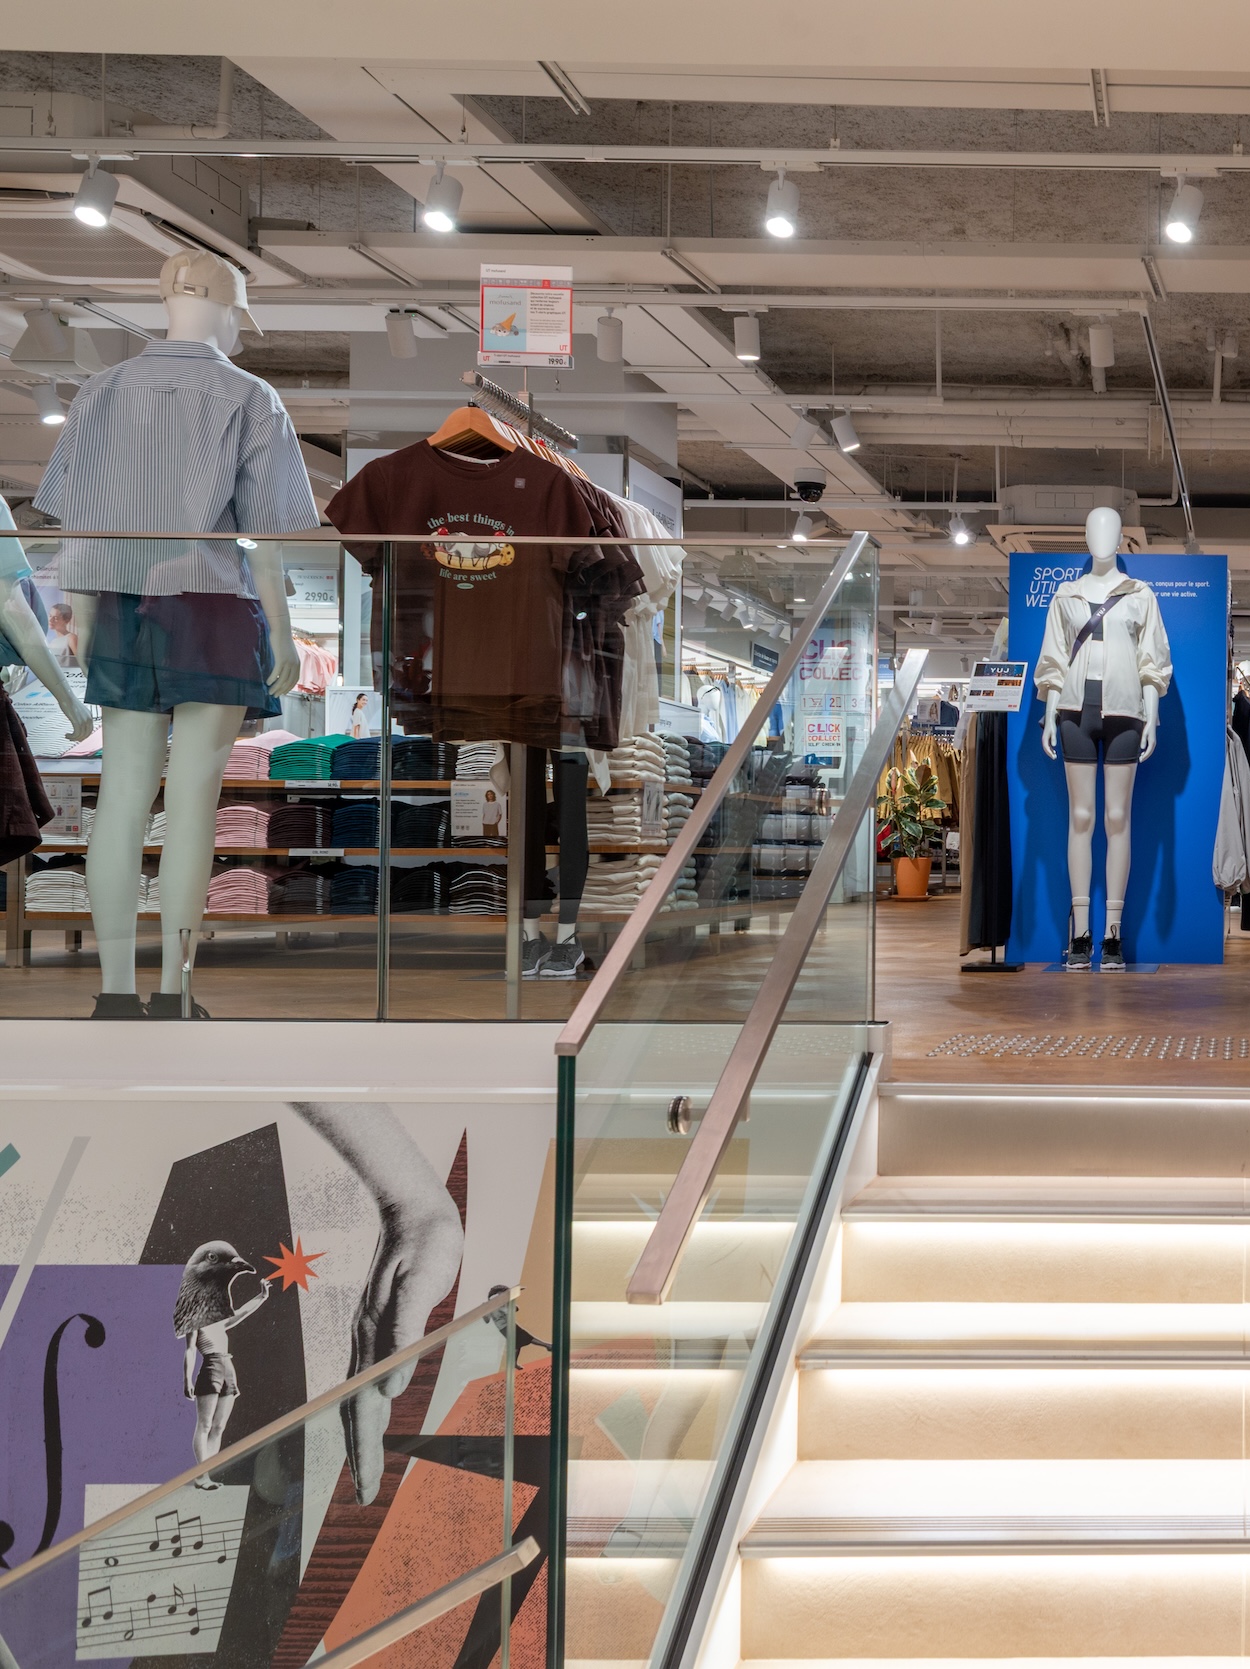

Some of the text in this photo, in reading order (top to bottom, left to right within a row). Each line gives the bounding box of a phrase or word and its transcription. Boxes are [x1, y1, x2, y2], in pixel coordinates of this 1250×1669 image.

[427, 512, 515, 536] the best things in
[439, 568, 497, 581] life are sweet
[1033, 567, 1083, 580] SPORT
[1030, 581, 1057, 594] UTIL
[305, 592, 328, 602] 29,90
[801, 640, 856, 660] CLIC
[800, 667, 862, 680] COLLEC
[830, 698, 835, 708] 2
[851, 698, 857, 708] 3
[808, 724, 840, 732] CLICK
